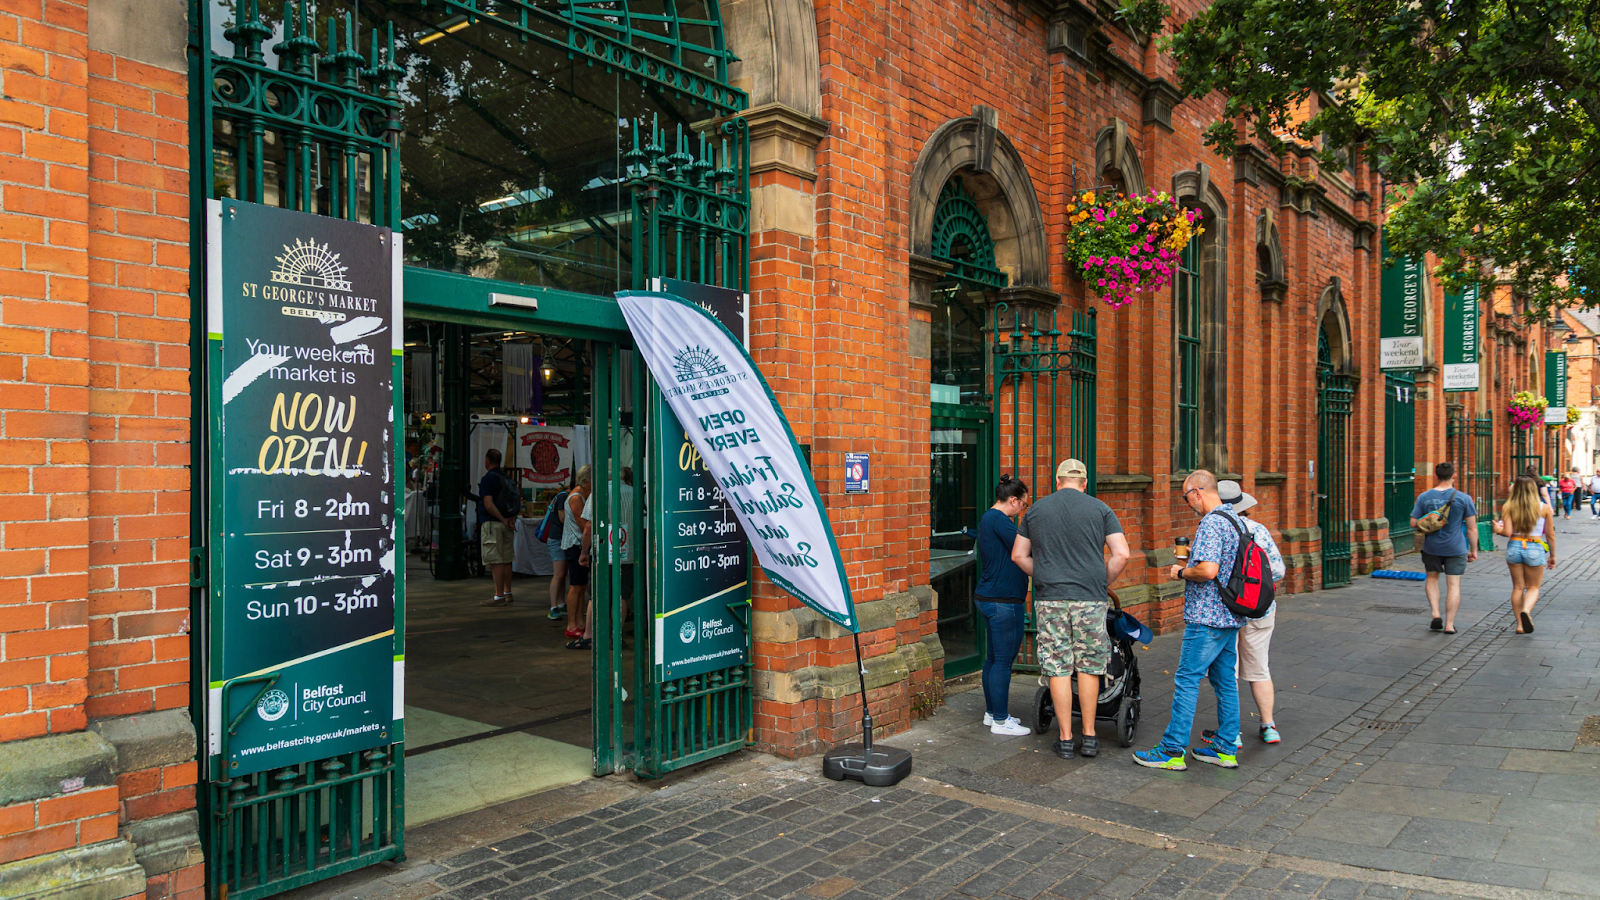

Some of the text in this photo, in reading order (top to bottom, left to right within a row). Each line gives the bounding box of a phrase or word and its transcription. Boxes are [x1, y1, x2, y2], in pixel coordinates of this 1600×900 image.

[242, 282, 377, 313] ST GEORGE'S MARKET
[1404, 273, 1417, 321] GEORGE'S
[1404, 323, 1417, 335] ST
[1462, 283, 1475, 363] ST GEORGE'S MARK
[246, 338, 375, 366] Your weekend
[1384, 347, 1419, 357] weekend
[1392, 340, 1412, 349] Your
[1386, 355, 1416, 366] market
[269, 365, 356, 385] market is
[270, 391, 356, 433] NOW
[258, 435, 368, 478] OPEN!
[678, 487, 694, 502] Fri
[697, 487, 705, 501] 8
[712, 487, 726, 504] 2p
[257, 500, 284, 519] Fri
[294, 499, 308, 518] 8
[325, 498, 370, 520] 2pm
[678, 522, 698, 537] Sat
[699, 521, 706, 535] 9
[714, 521, 737, 537] 3pm
[255, 550, 292, 569] Sat
[296, 547, 311, 567] 9
[327, 546, 372, 568] 3pm
[674, 557, 697, 572] Sun
[698, 556, 710, 570] 10
[717, 554, 740, 571] 3pm
[246, 600, 290, 620] Sun
[293, 595, 317, 615] 10
[333, 593, 378, 614] 3pm
[702, 619, 723, 630] Belfast
[702, 629, 714, 639] City
[714, 624, 734, 636] Council
[302, 683, 344, 700] Belfast
[302, 691, 367, 713] City Council
[241, 722, 380, 757] www.belfastcity.gov.uk/markets
